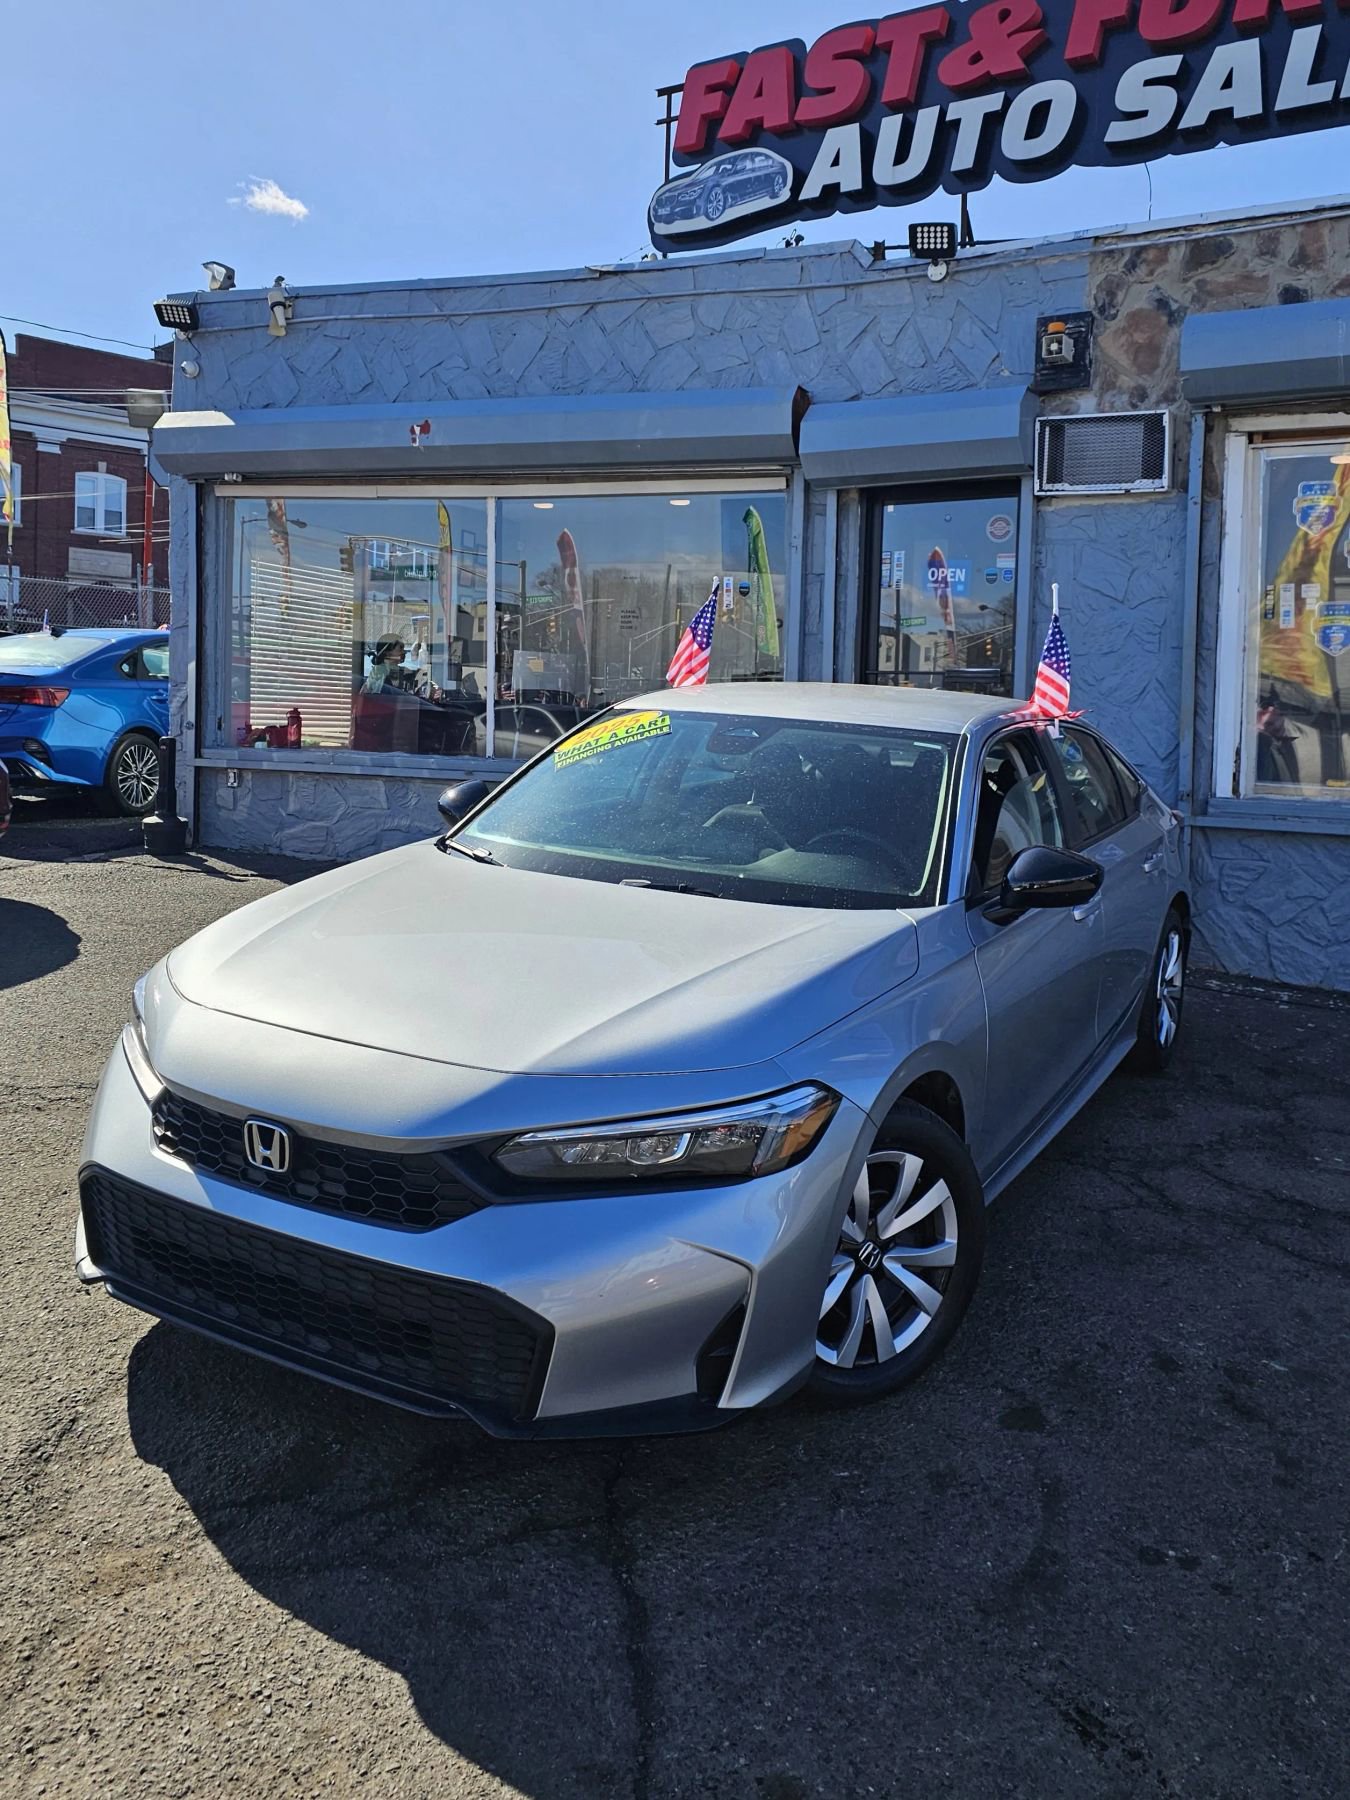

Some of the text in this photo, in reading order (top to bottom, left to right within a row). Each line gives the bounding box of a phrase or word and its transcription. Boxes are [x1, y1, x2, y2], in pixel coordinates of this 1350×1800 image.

[673, 6, 949, 154] FAST
[938, 0, 1047, 89] &
[799, 24, 1350, 201] AUTO SAL
[928, 567, 966, 582] OPEN
[556, 736, 604, 760] WHAT
[609, 732, 619, 742] A
[557, 725, 670, 768] FINANCING AVAILABLE
[574, 714, 642, 744] 2025
